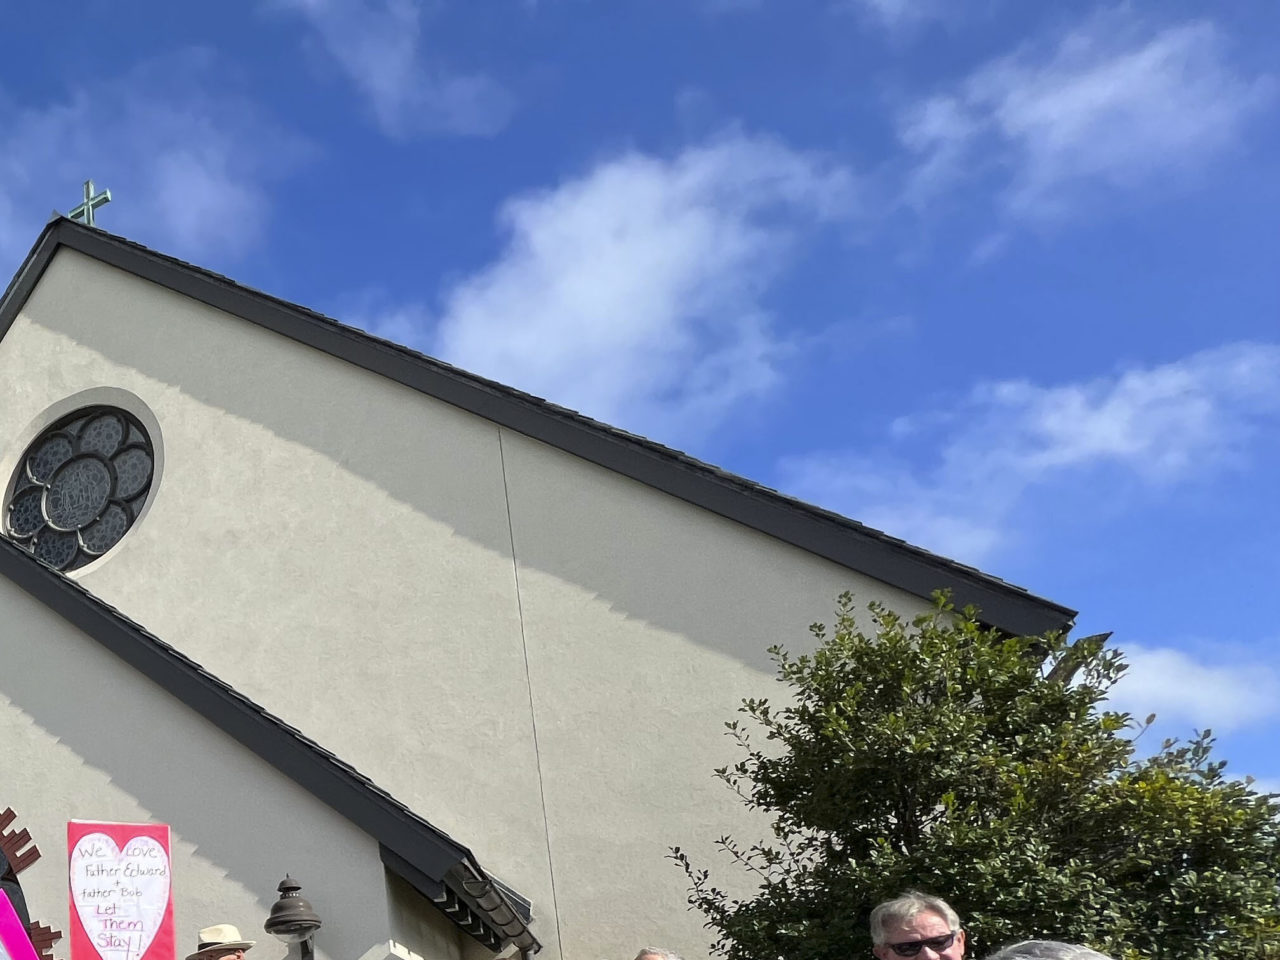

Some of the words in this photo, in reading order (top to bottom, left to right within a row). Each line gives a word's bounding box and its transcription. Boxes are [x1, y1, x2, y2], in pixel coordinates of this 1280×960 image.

[79, 843, 106, 858] We
[85, 864, 121, 877] Father
[123, 862, 167, 878] Edward
[121, 887, 143, 898] Bob
[96, 903, 121, 916] Let
[99, 919, 144, 931] Them
